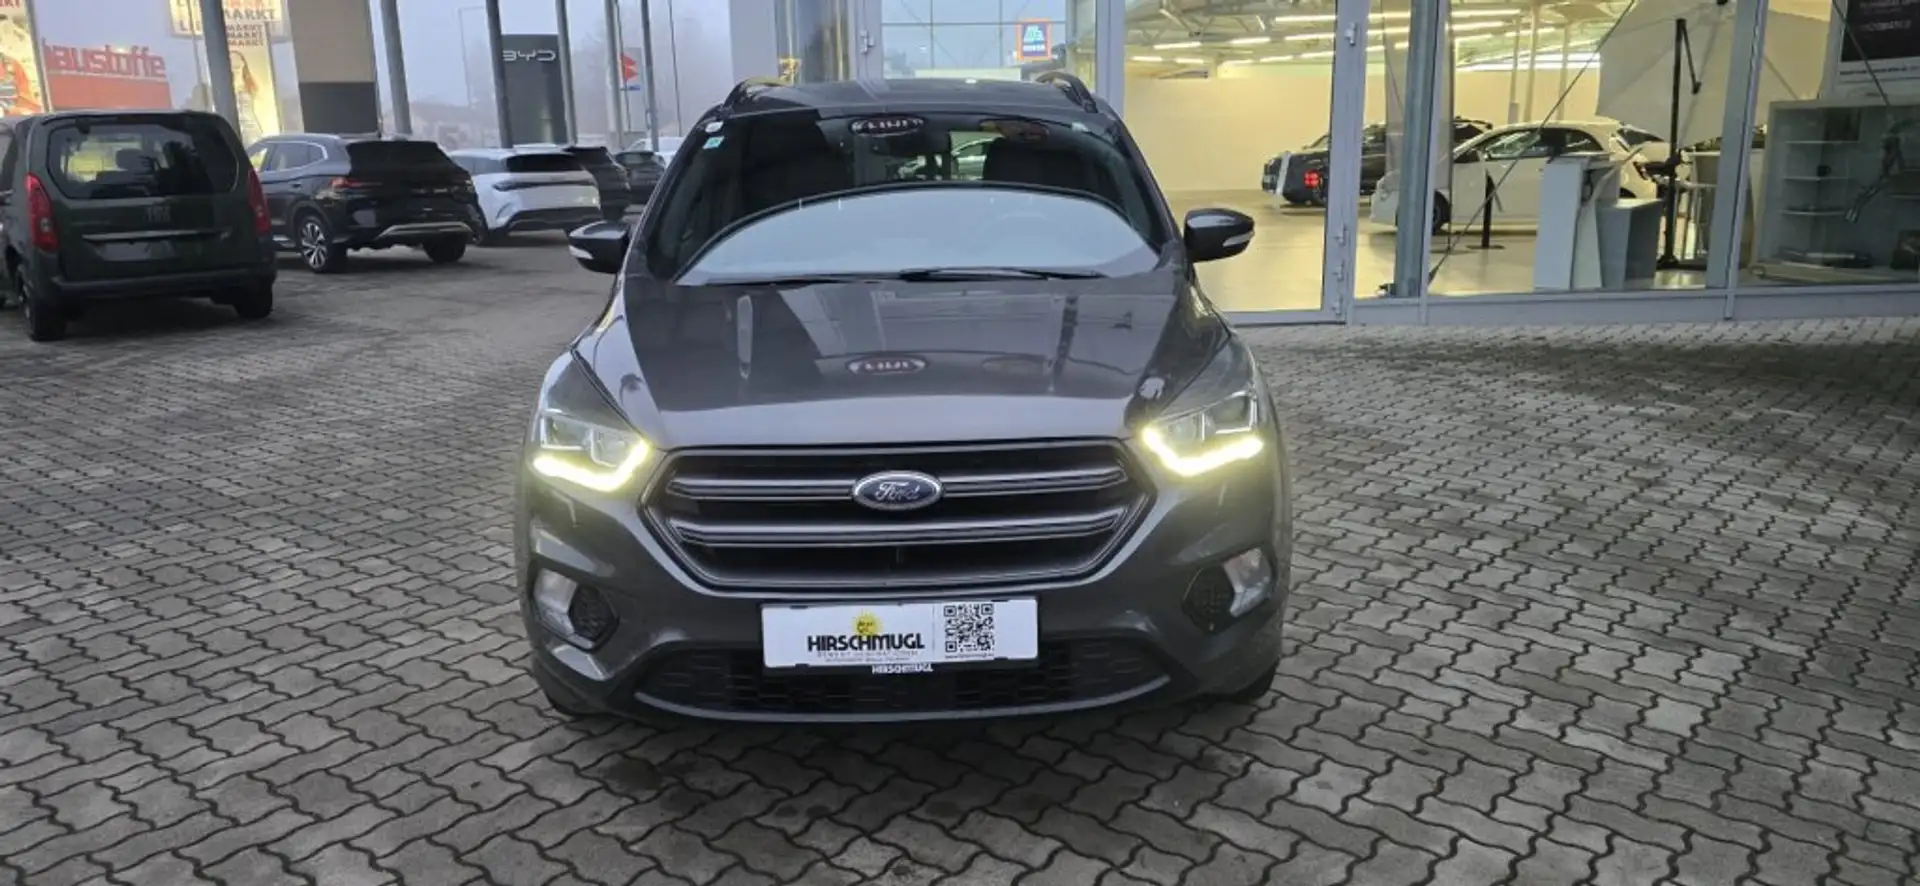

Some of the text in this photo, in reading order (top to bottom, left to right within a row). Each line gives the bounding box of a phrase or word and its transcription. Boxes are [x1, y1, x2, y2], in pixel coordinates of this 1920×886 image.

[502, 49, 556, 62] BYD
[875, 481, 921, 501] Ford
[807, 633, 925, 652] HIRSCHMUGL
